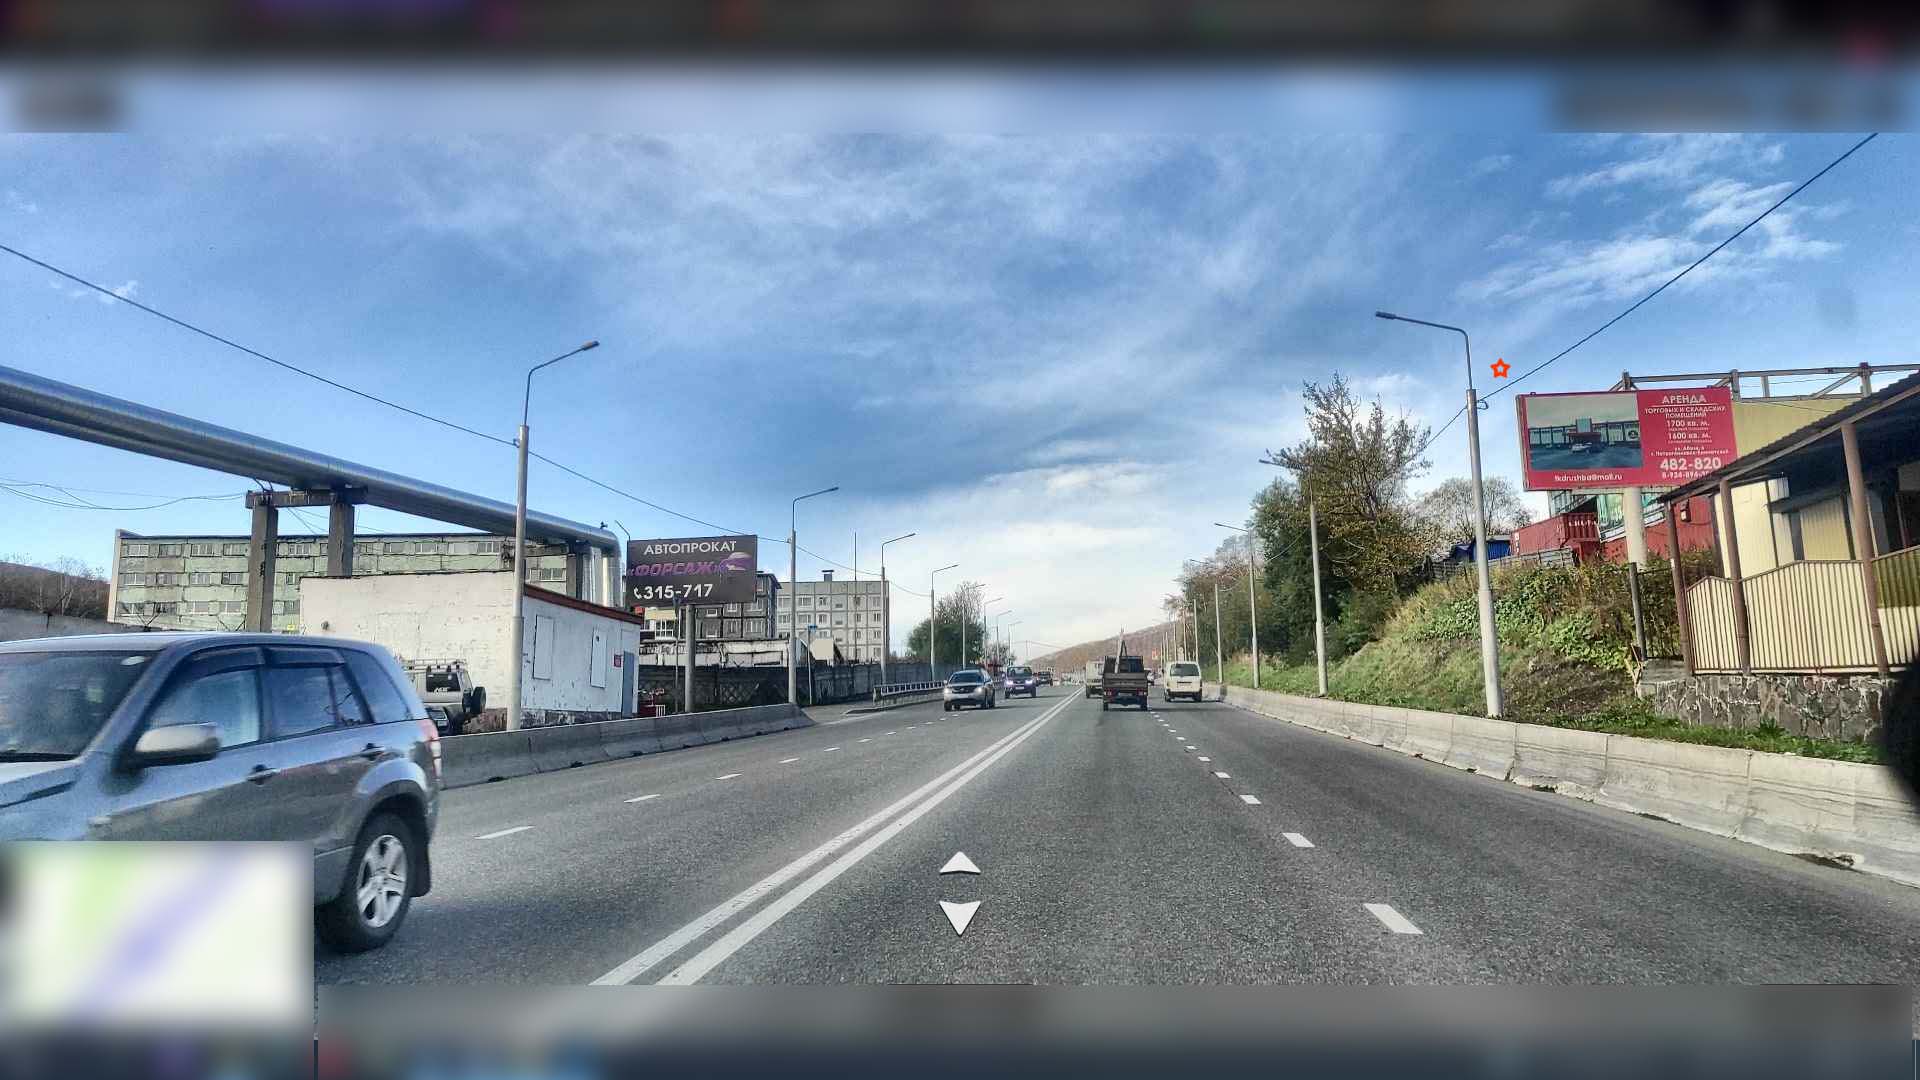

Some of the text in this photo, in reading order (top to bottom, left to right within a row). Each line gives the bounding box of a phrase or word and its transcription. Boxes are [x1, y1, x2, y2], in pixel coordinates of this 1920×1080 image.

[1662, 394, 1707, 404] АРЕНДА
[1645, 407, 1679, 415] ТОРГОВЫХ
[1685, 405, 1726, 413] СКЛАДСКИХ
[1668, 432, 1686, 440] 1600
[1660, 457, 1722, 471] 482-820
[643, 541, 737, 556] АВТОПРОКАТ
[643, 584, 713, 600] 315-717
